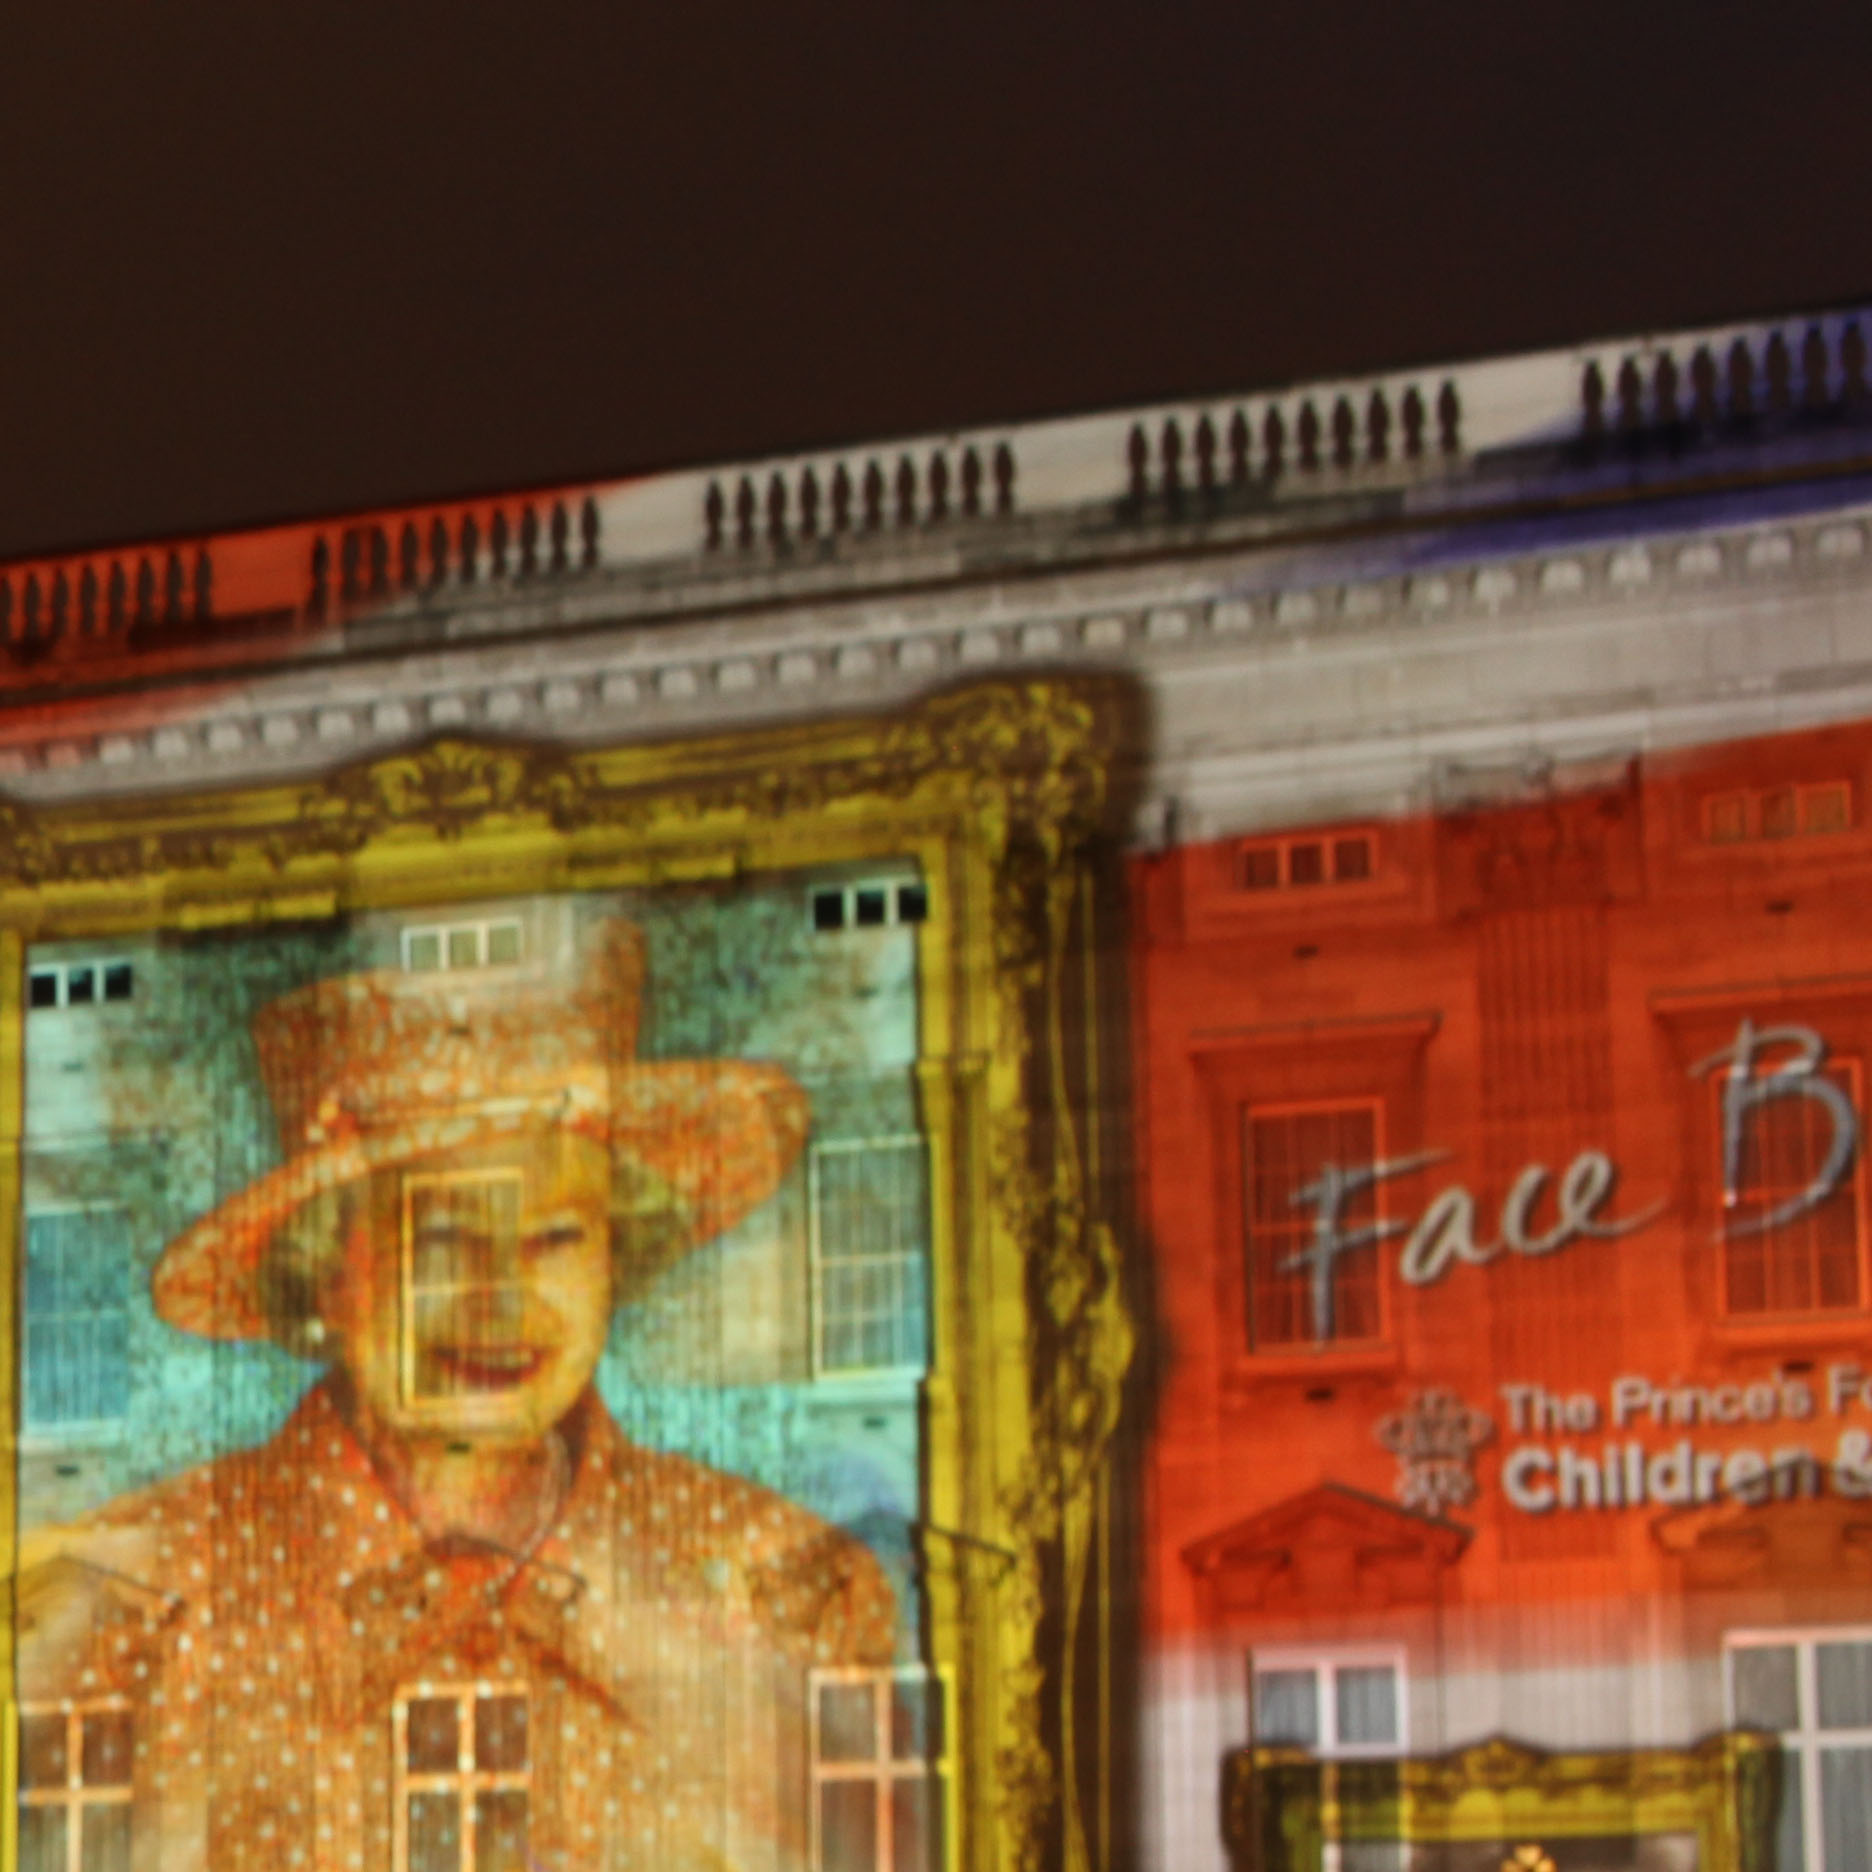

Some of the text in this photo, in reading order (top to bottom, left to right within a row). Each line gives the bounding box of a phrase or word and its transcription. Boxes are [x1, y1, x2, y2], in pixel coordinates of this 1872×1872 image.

[1278, 1148, 1668, 1352] Face
[1501, 1382, 1598, 1432] The
[1611, 1371, 1814, 1428] Prince's
[1502, 1436, 1819, 1514] Children
